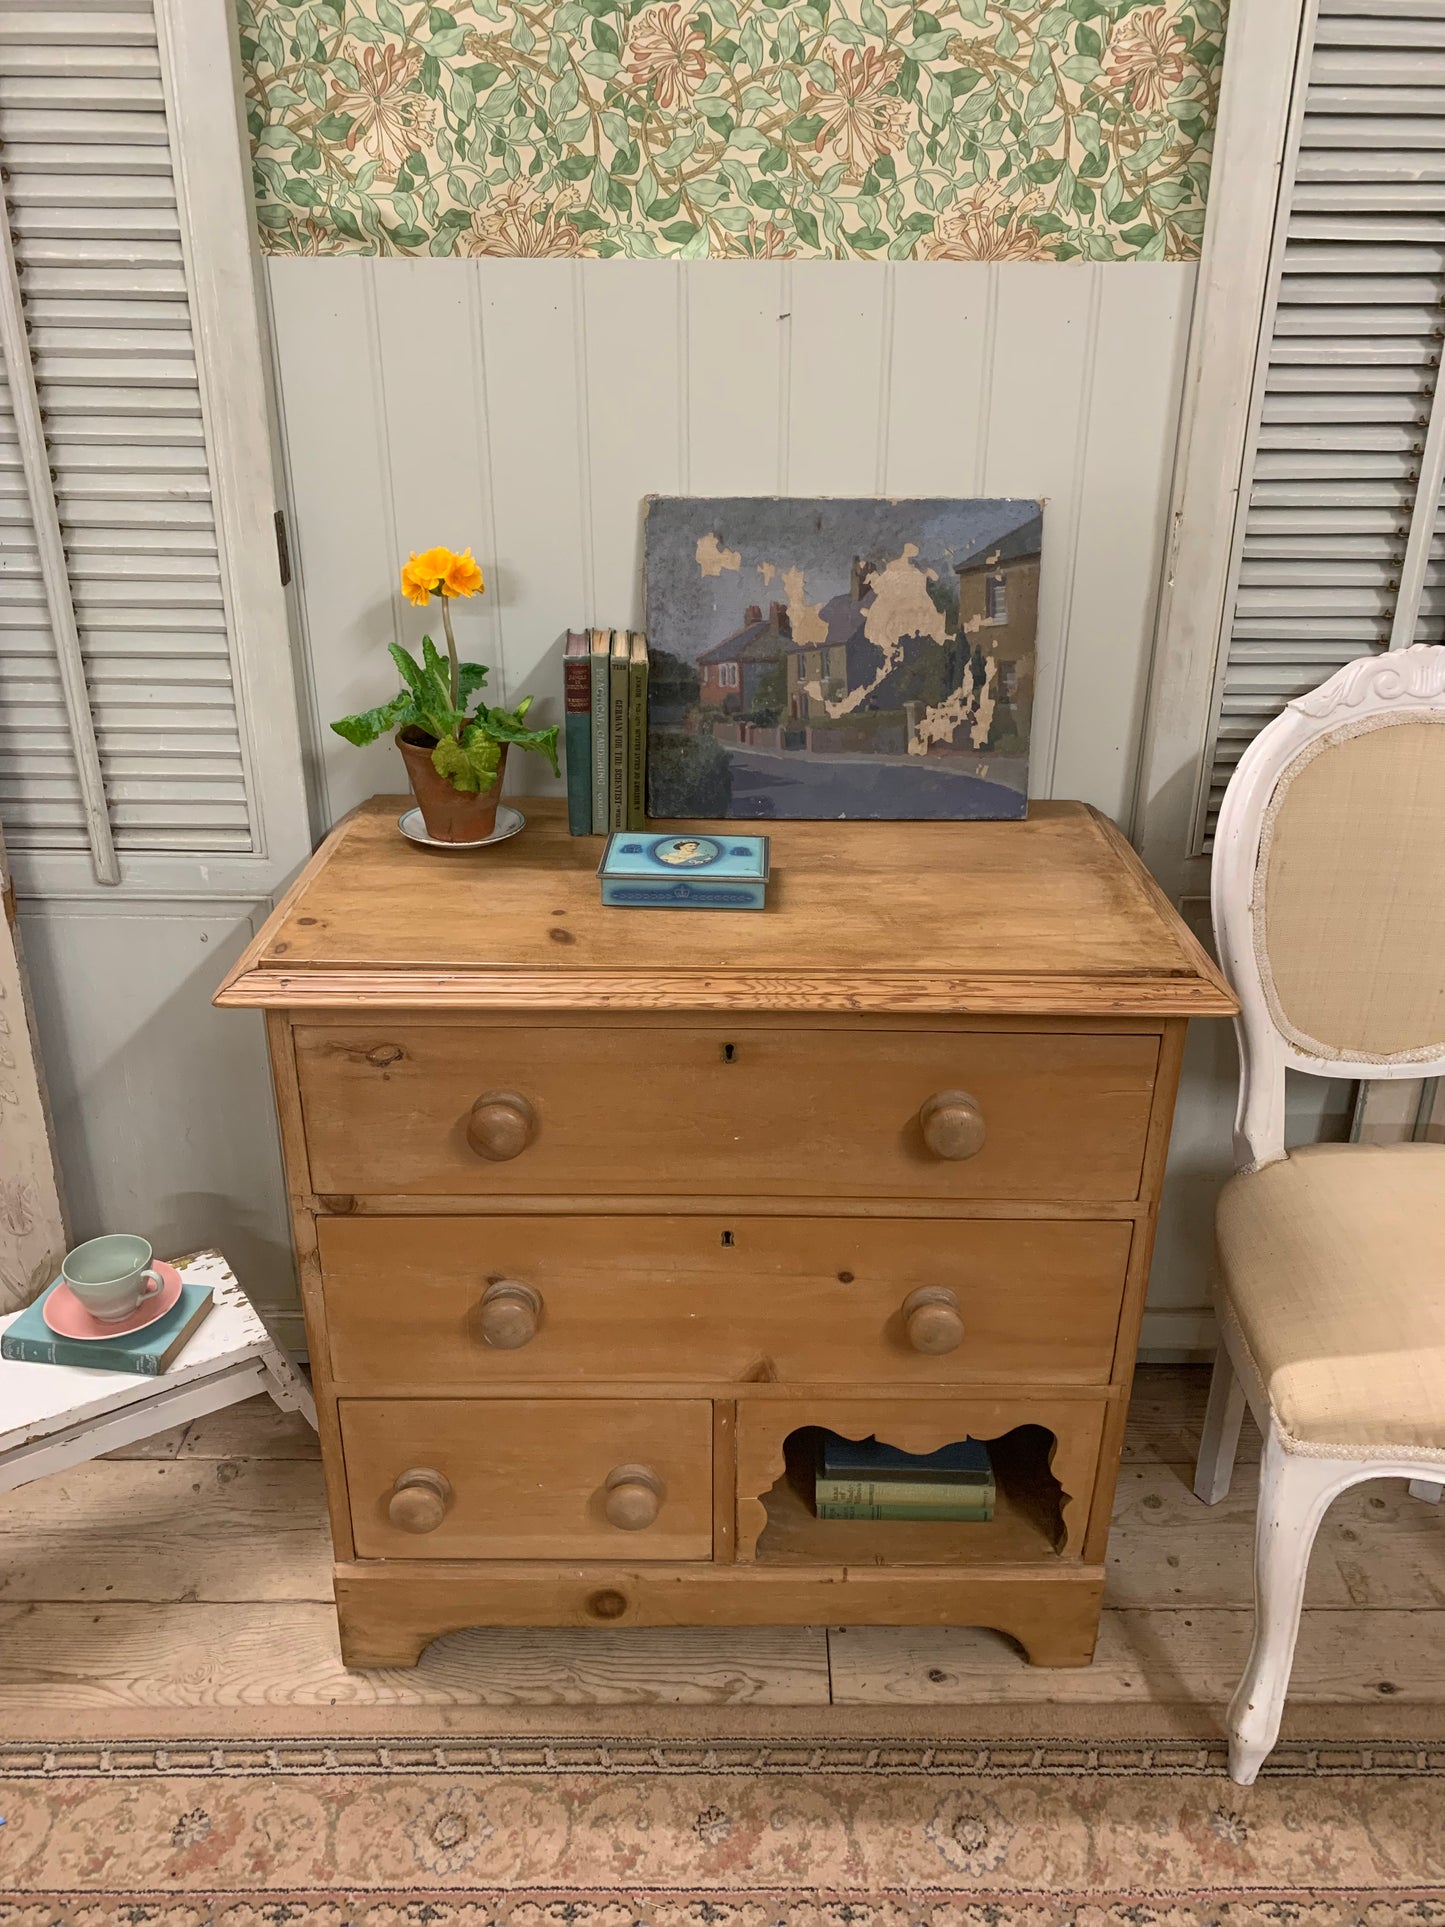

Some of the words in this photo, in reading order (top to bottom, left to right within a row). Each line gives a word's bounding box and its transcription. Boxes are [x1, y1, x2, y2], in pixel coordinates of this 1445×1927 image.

[596, 668, 605, 725] PRACTICAL
[615, 700, 623, 731] GERMAN
[596, 728, 606, 785] GARDENING
[615, 735, 623, 749] FOR
[614, 753, 623, 766] THE
[614, 769, 622, 804] SCIENTIST
